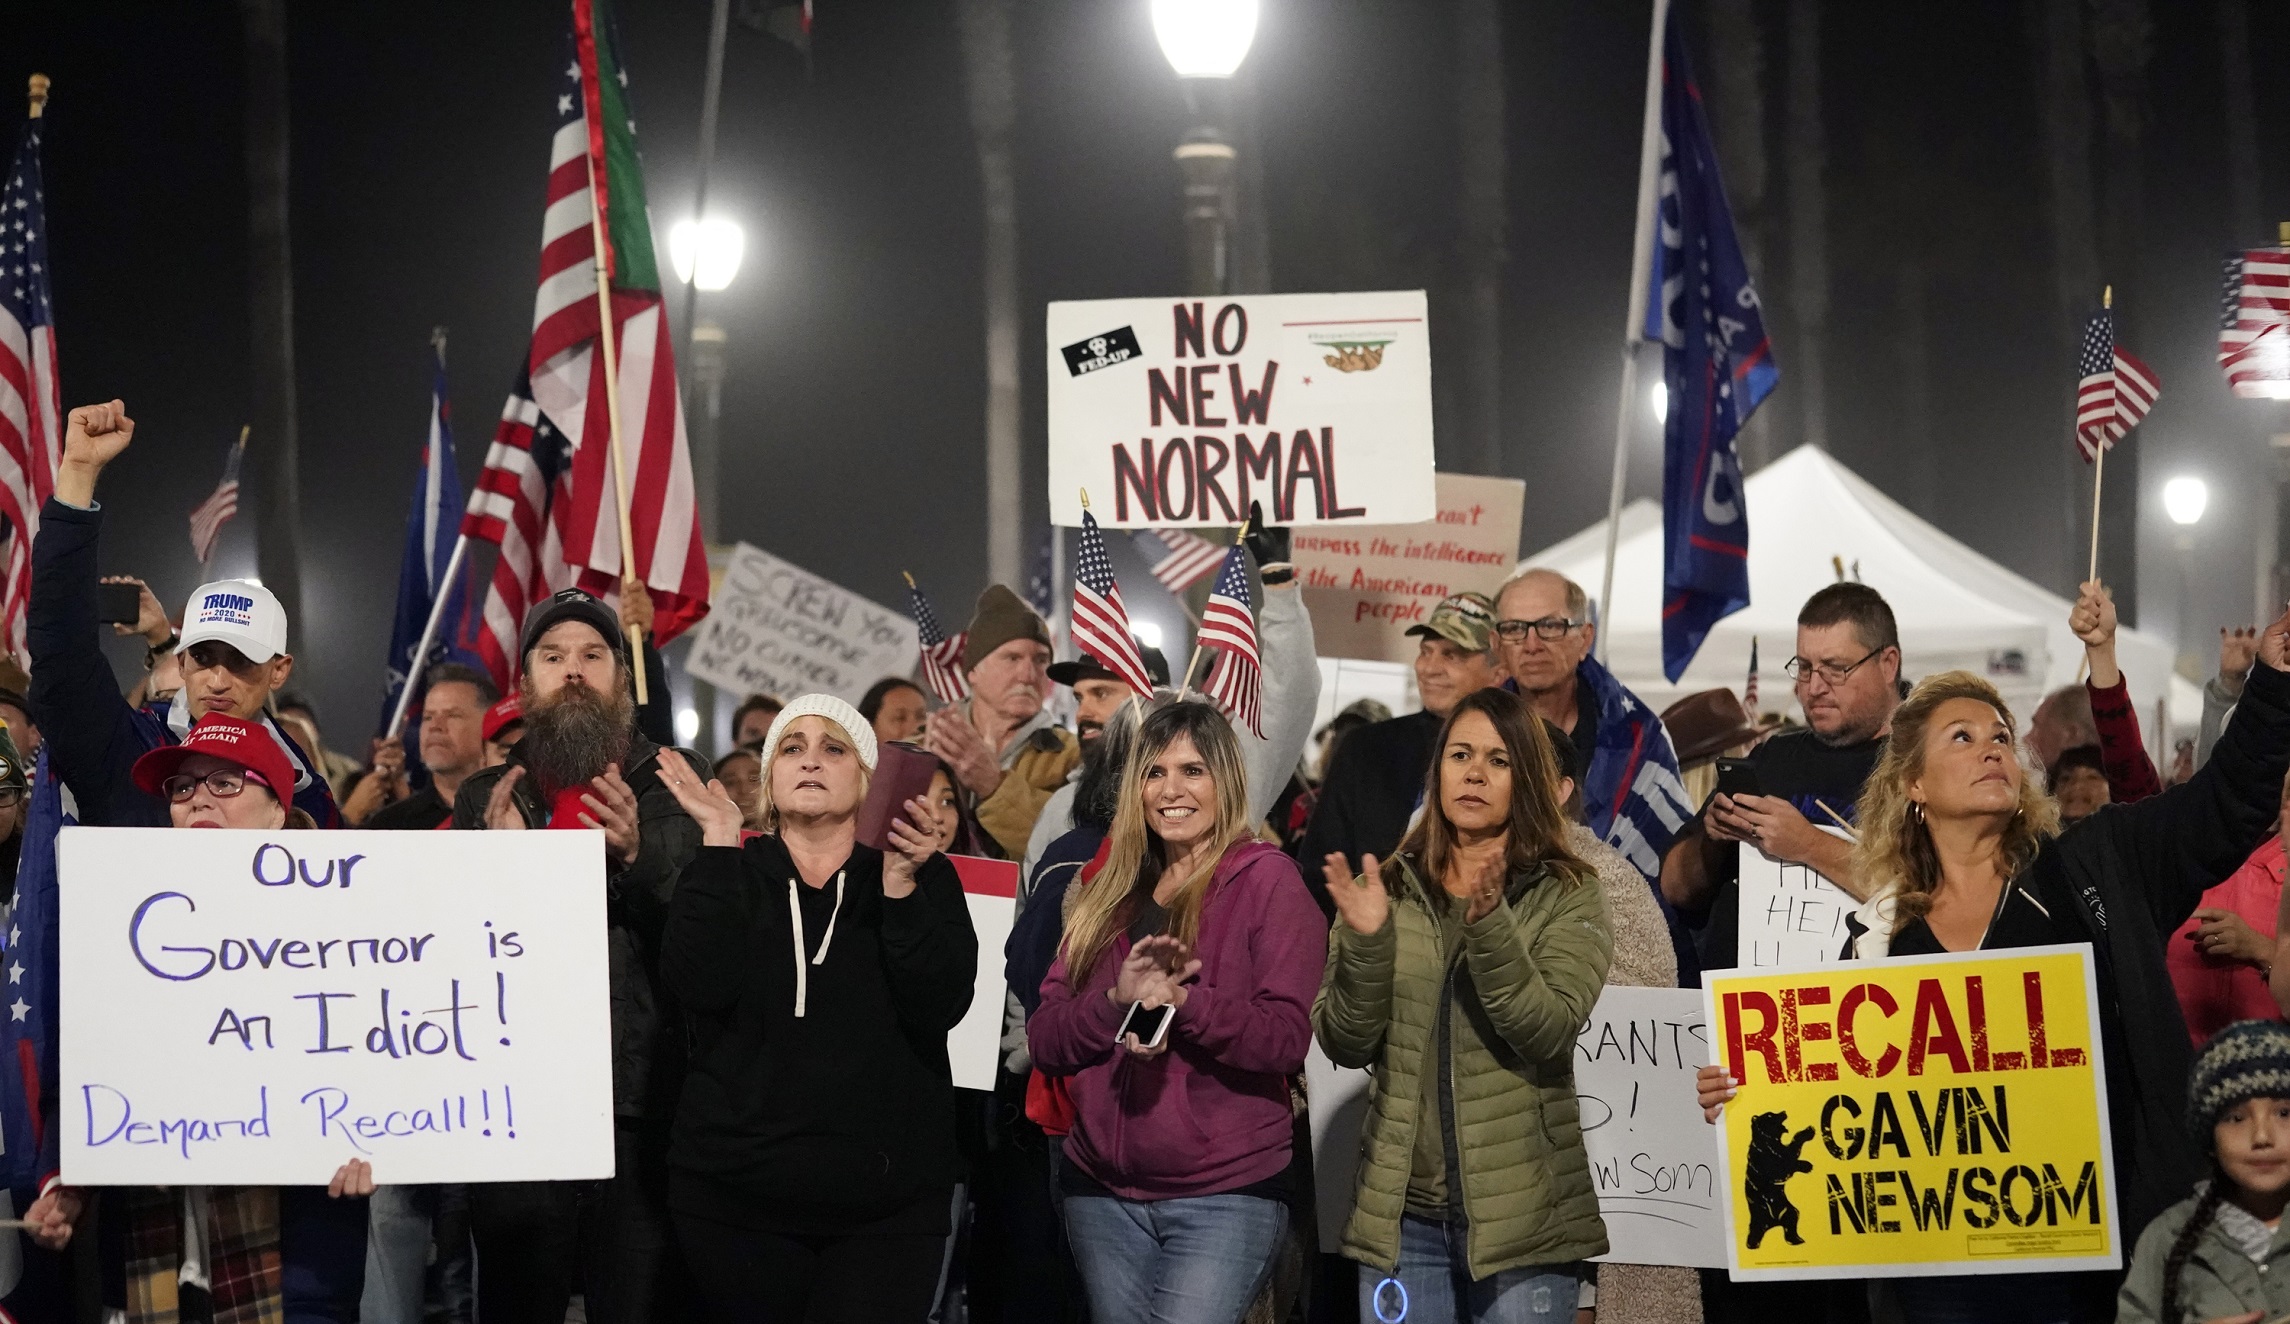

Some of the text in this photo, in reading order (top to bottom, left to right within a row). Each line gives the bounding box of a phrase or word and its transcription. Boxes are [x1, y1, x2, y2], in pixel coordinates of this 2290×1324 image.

[1173, 302, 1248, 359] NO
[1077, 348, 1131, 374] FED-UP
[1147, 359, 1280, 428] NEW
[1111, 427, 1367, 523] NORMAL
[1369, 537, 1399, 557] the
[1308, 565, 1338, 588] the
[203, 593, 254, 612] TRUMP
[214, 609, 235, 618] 2020
[1355, 601, 1425, 624] people
[224, 617, 250, 627] BULLSHIT
[194, 725, 247, 737] AMERICA
[198, 733, 239, 744] AGAIN
[252, 842, 367, 888] Our
[128, 891, 524, 981] Governor is
[1722, 971, 2088, 1086] RECALL
[300, 1084, 517, 1155] Recall!!
[1820, 1085, 2011, 1161] GAVIN
[1826, 1161, 2101, 1236] NEWSOM
